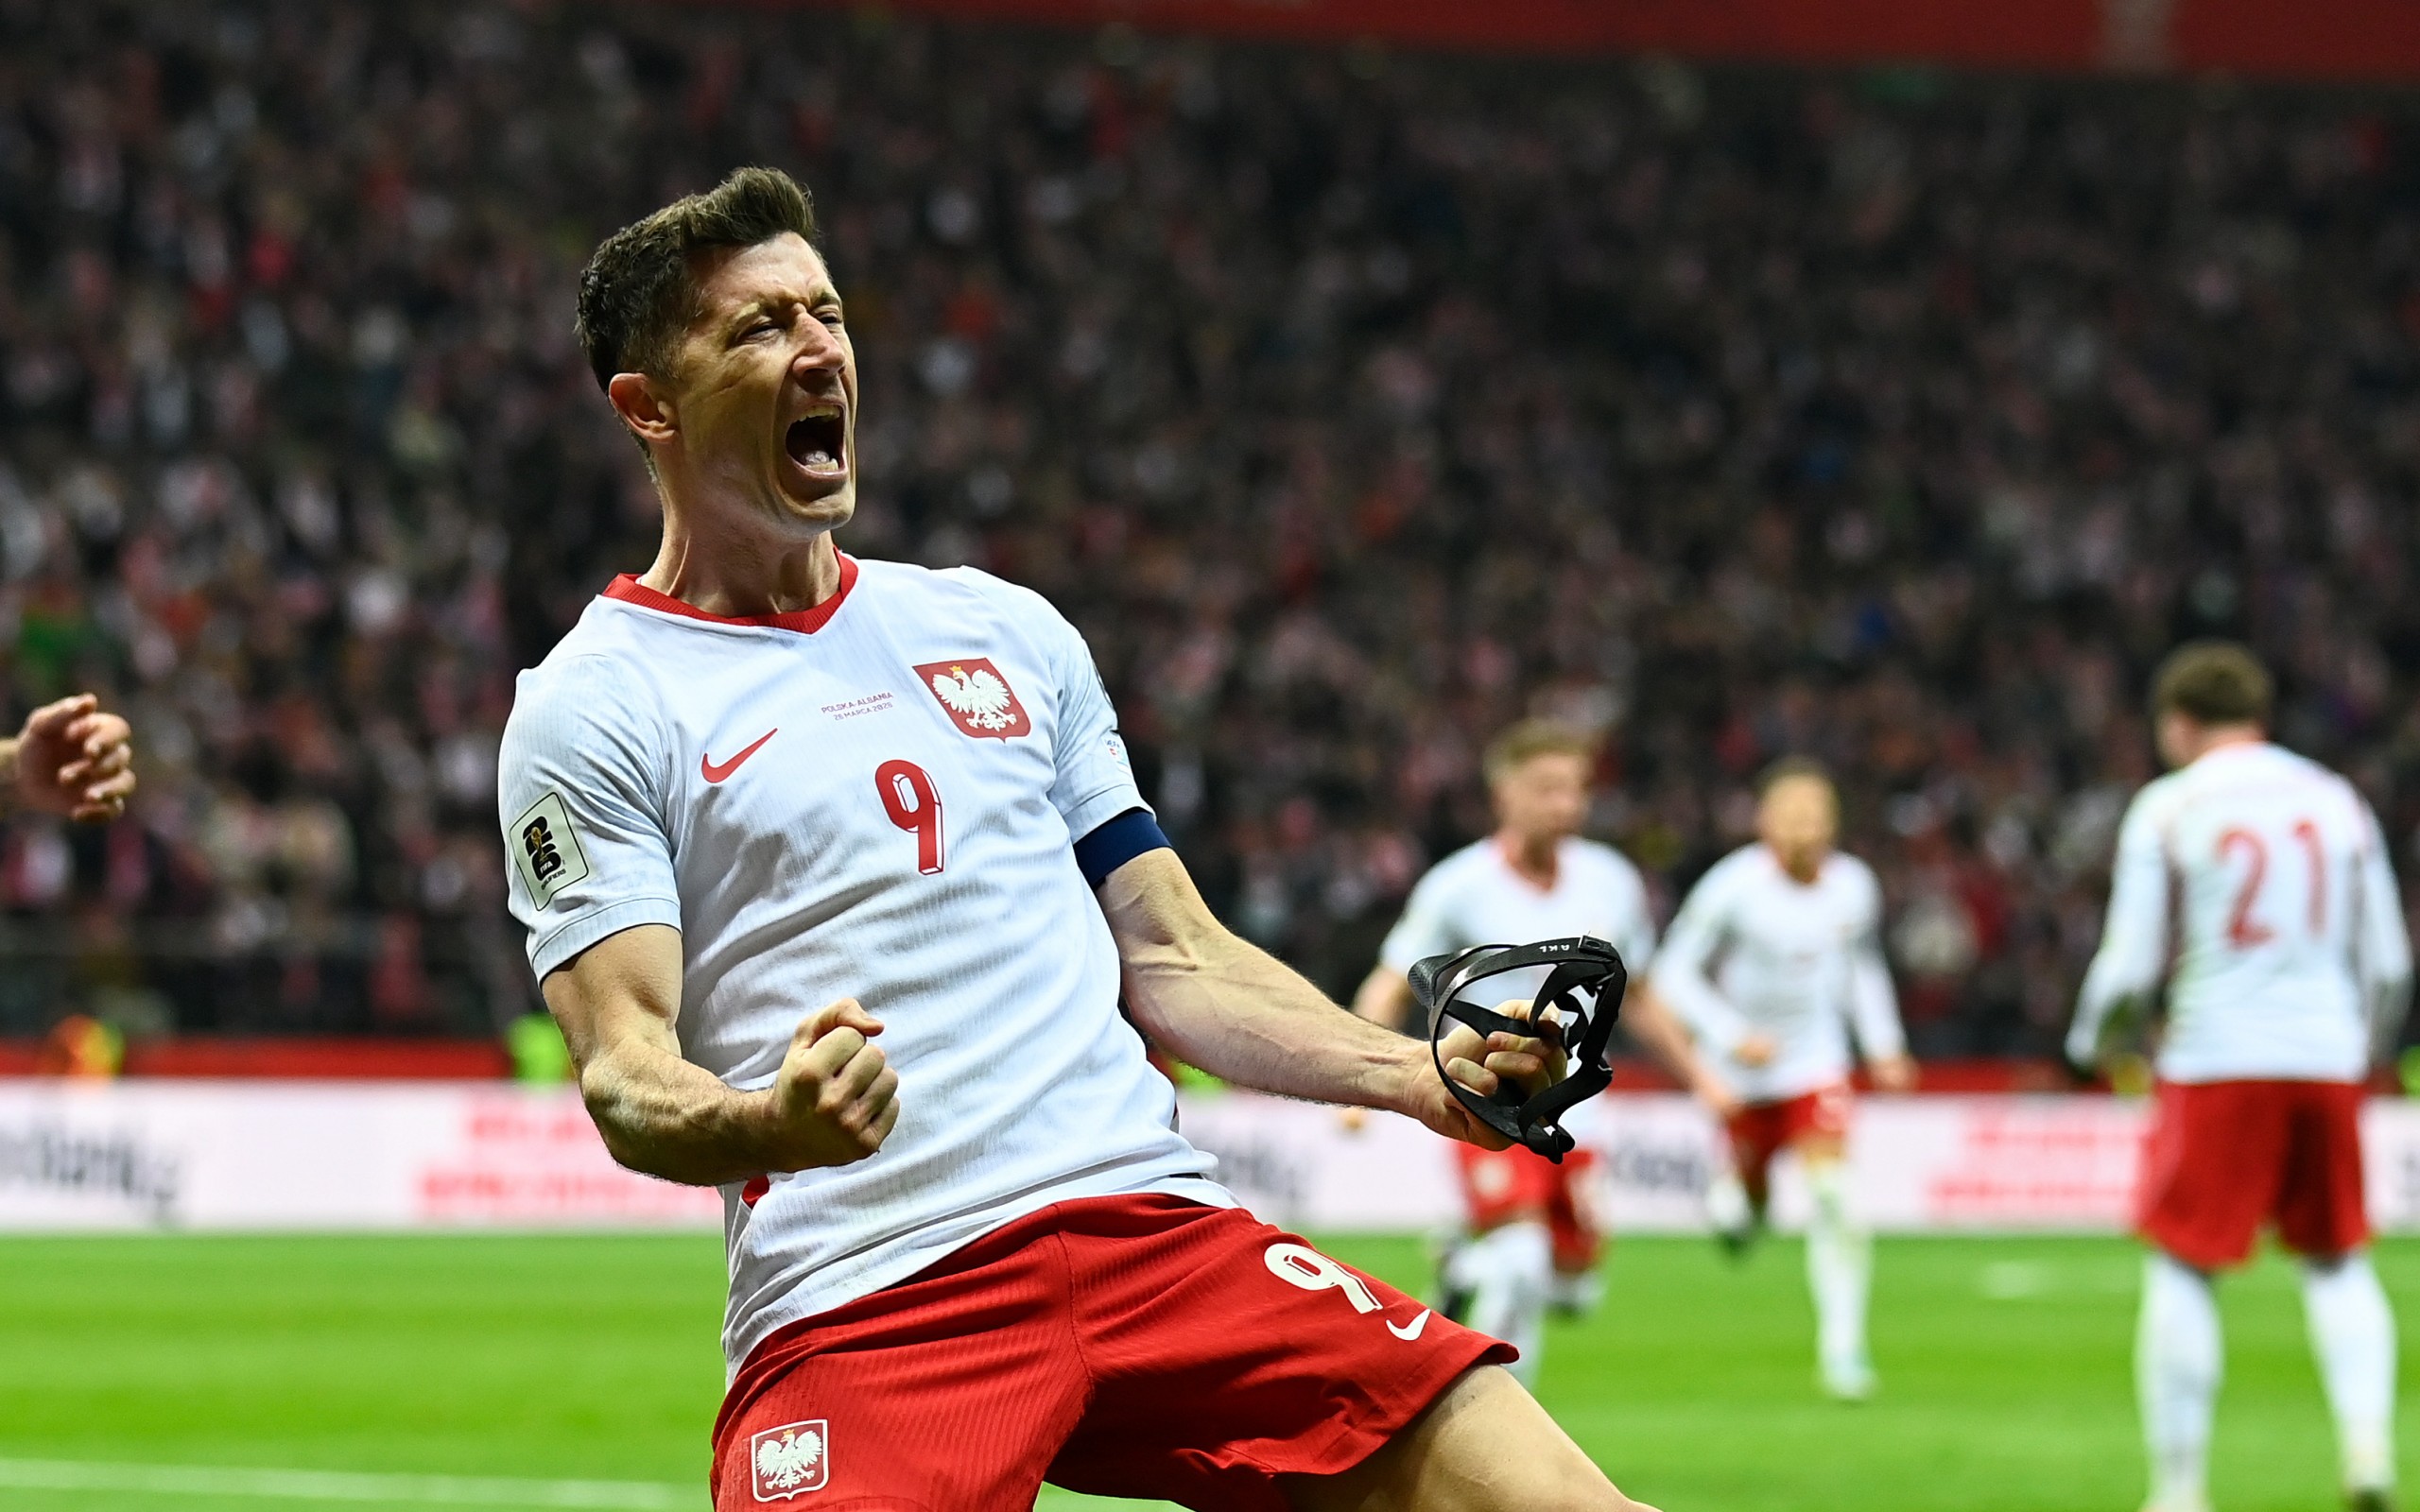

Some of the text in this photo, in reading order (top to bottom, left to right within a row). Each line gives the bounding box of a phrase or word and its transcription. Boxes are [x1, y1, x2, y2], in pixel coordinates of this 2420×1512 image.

[844, 708, 872, 718] MARCA
[874, 759, 944, 875] 9
[2214, 816, 2329, 949] 21
[1264, 1243, 1383, 1314] 9
